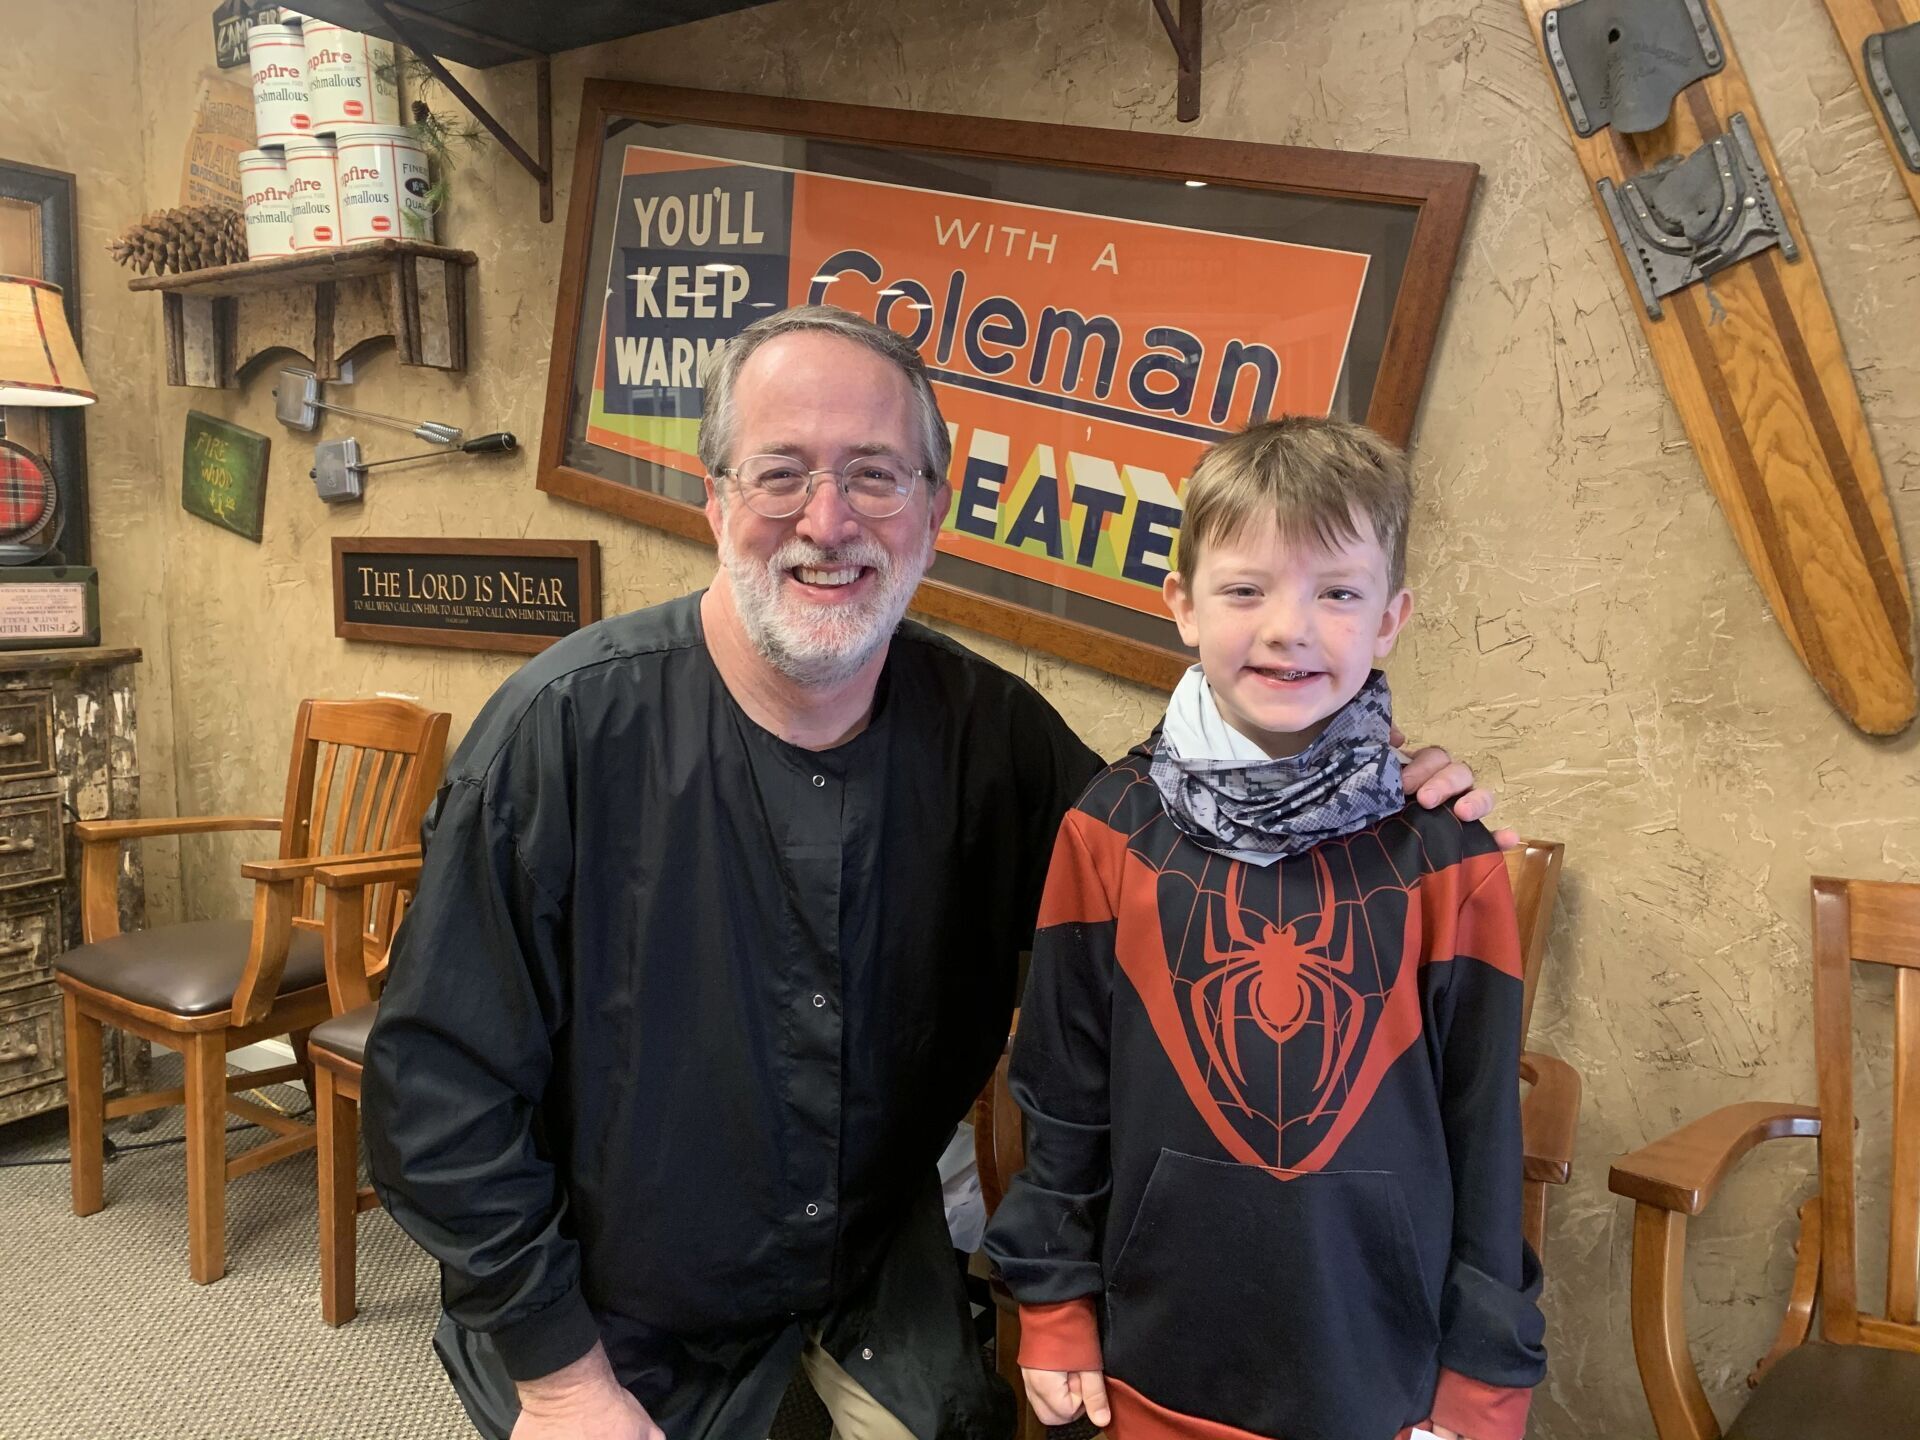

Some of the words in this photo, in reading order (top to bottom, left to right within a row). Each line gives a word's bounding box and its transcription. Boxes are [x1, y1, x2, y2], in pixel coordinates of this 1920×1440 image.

[633, 186, 765, 248] YOU'LL
[933, 214, 1058, 264] WITH
[1090, 242, 1120, 275] A
[635, 264, 750, 319] KEEP
[807, 248, 1282, 426] Coleman
[194, 431, 229, 462] FIRE
[947, 422, 1188, 589] EATE
[394, 602, 411, 613] CALL
[451, 605, 465, 616] ALL
[465, 605, 484, 617] WHO
[485, 606, 504, 618] CALL
